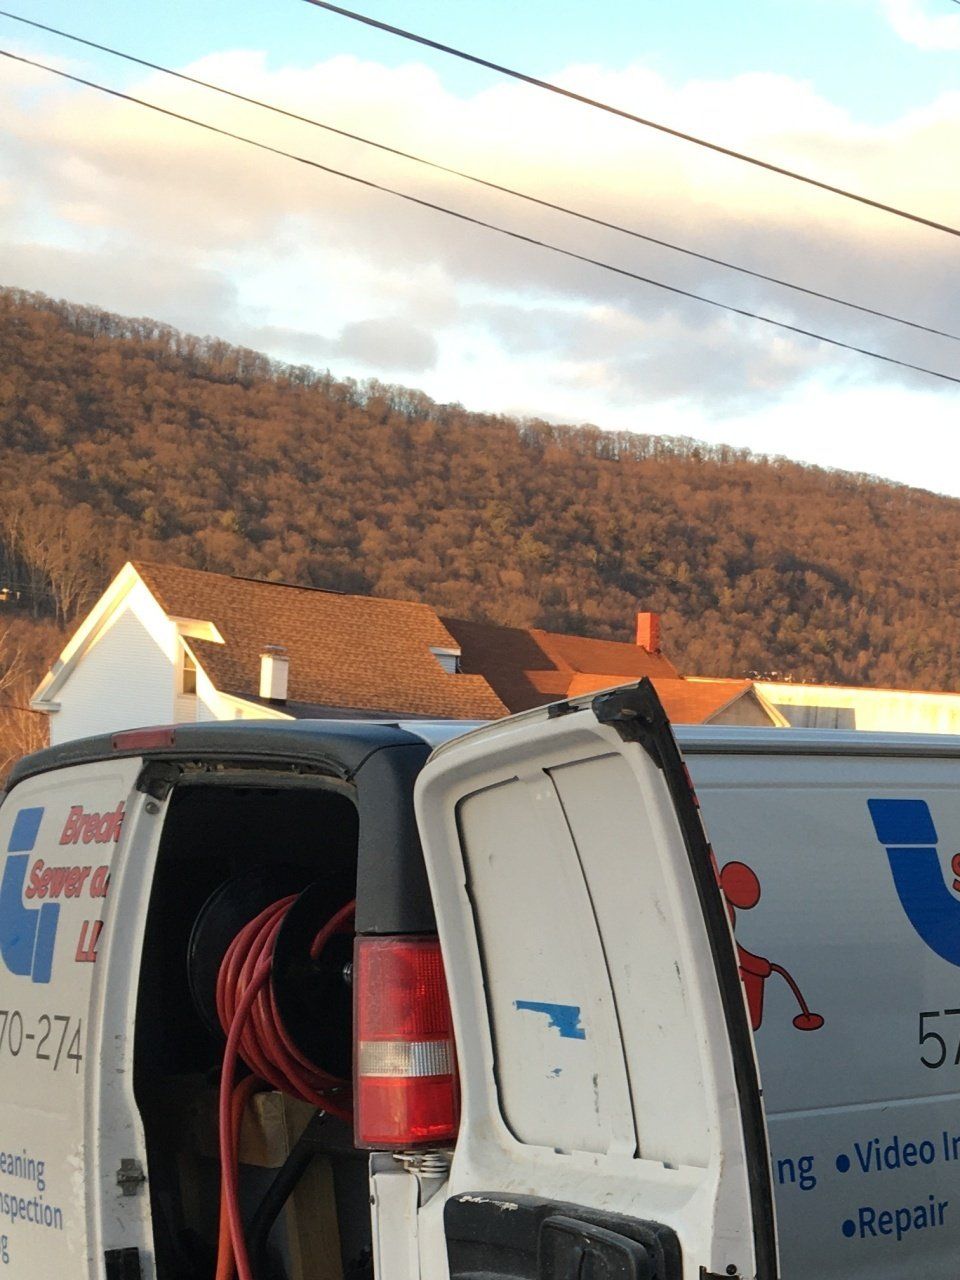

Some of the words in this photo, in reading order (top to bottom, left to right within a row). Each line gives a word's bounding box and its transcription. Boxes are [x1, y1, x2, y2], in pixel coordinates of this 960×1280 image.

[25, 859, 92, 899] Sewer
[854, 1136, 936, 1173] Video
[857, 1195, 949, 1241] Repair
